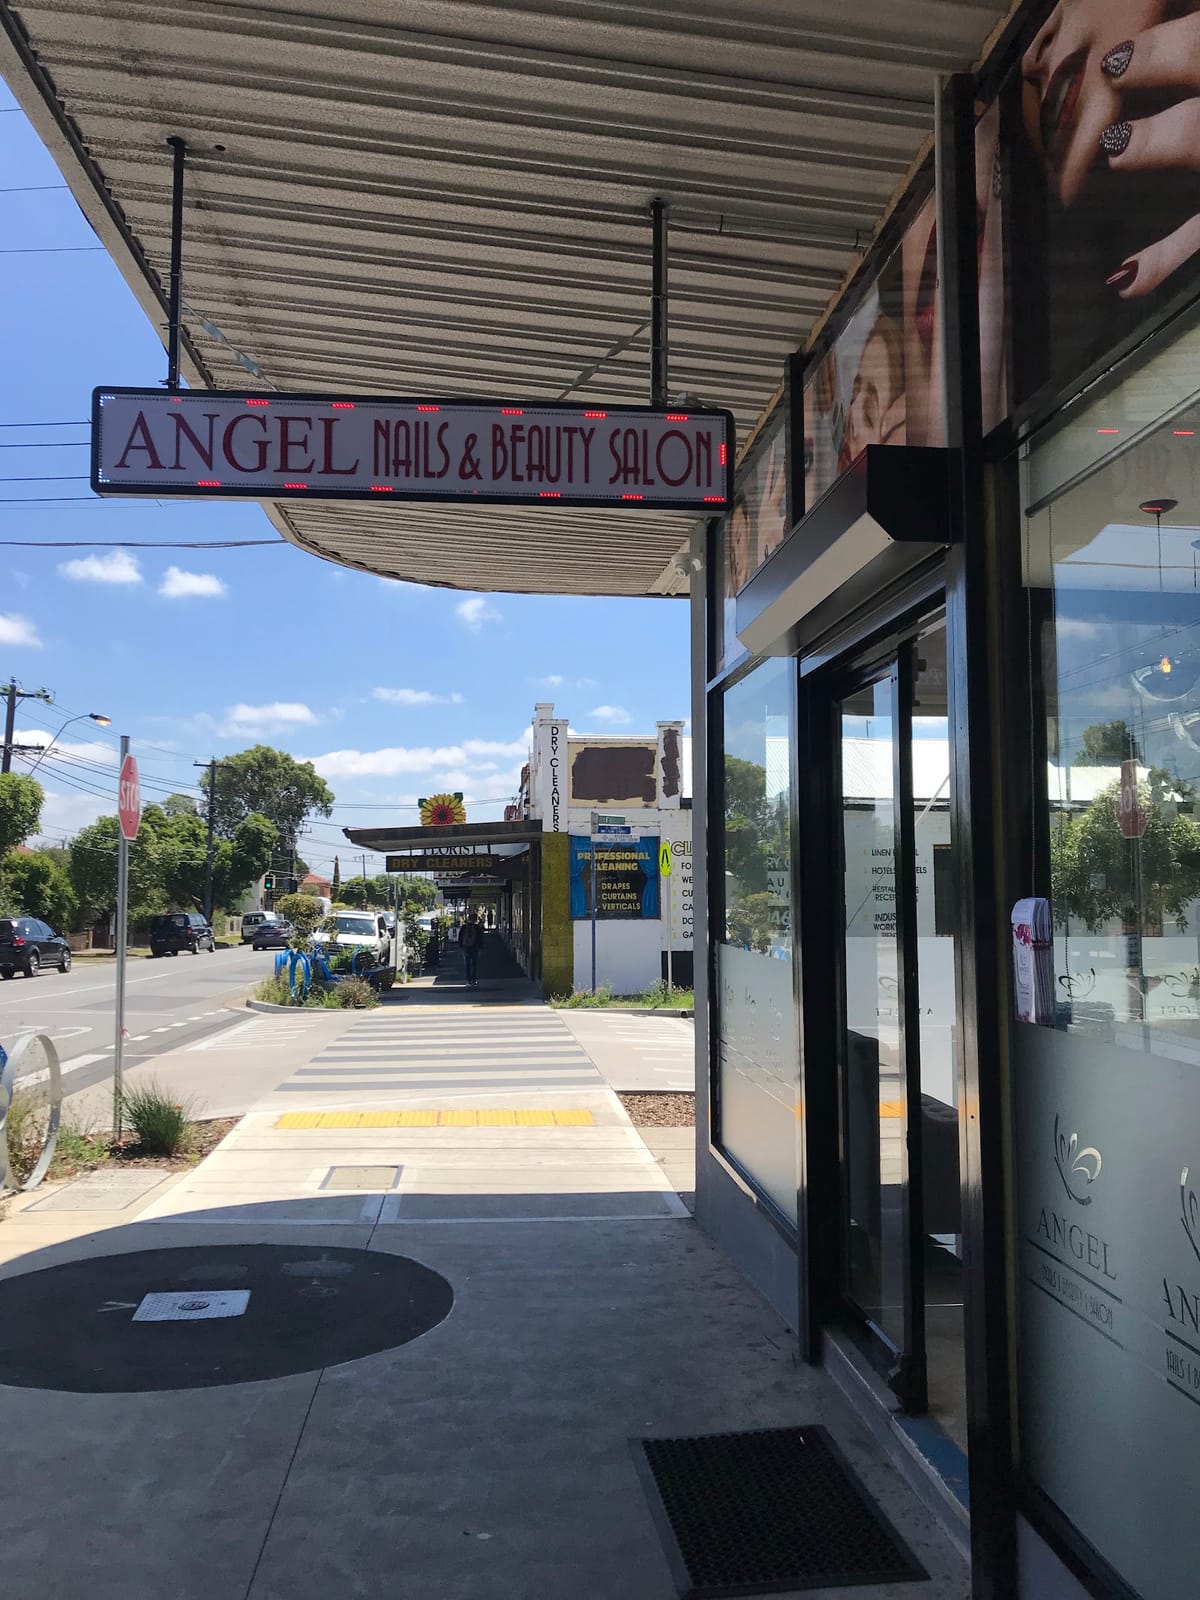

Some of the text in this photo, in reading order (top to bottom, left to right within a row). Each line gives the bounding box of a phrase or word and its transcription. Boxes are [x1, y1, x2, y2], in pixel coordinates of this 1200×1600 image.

[114, 410, 712, 487] ANGEL NAILS & BEAUTY SALON
[550, 726, 560, 833] DRY CLEANERS
[671, 840, 693, 856] CL
[391, 857, 493, 868] DRY CLEANERS
[577, 852, 651, 860] PROFESSIONAL
[591, 862, 638, 871] LEANING
[601, 902, 641, 911] VERTICALS
[1037, 1208, 1117, 1281] ANGEL
